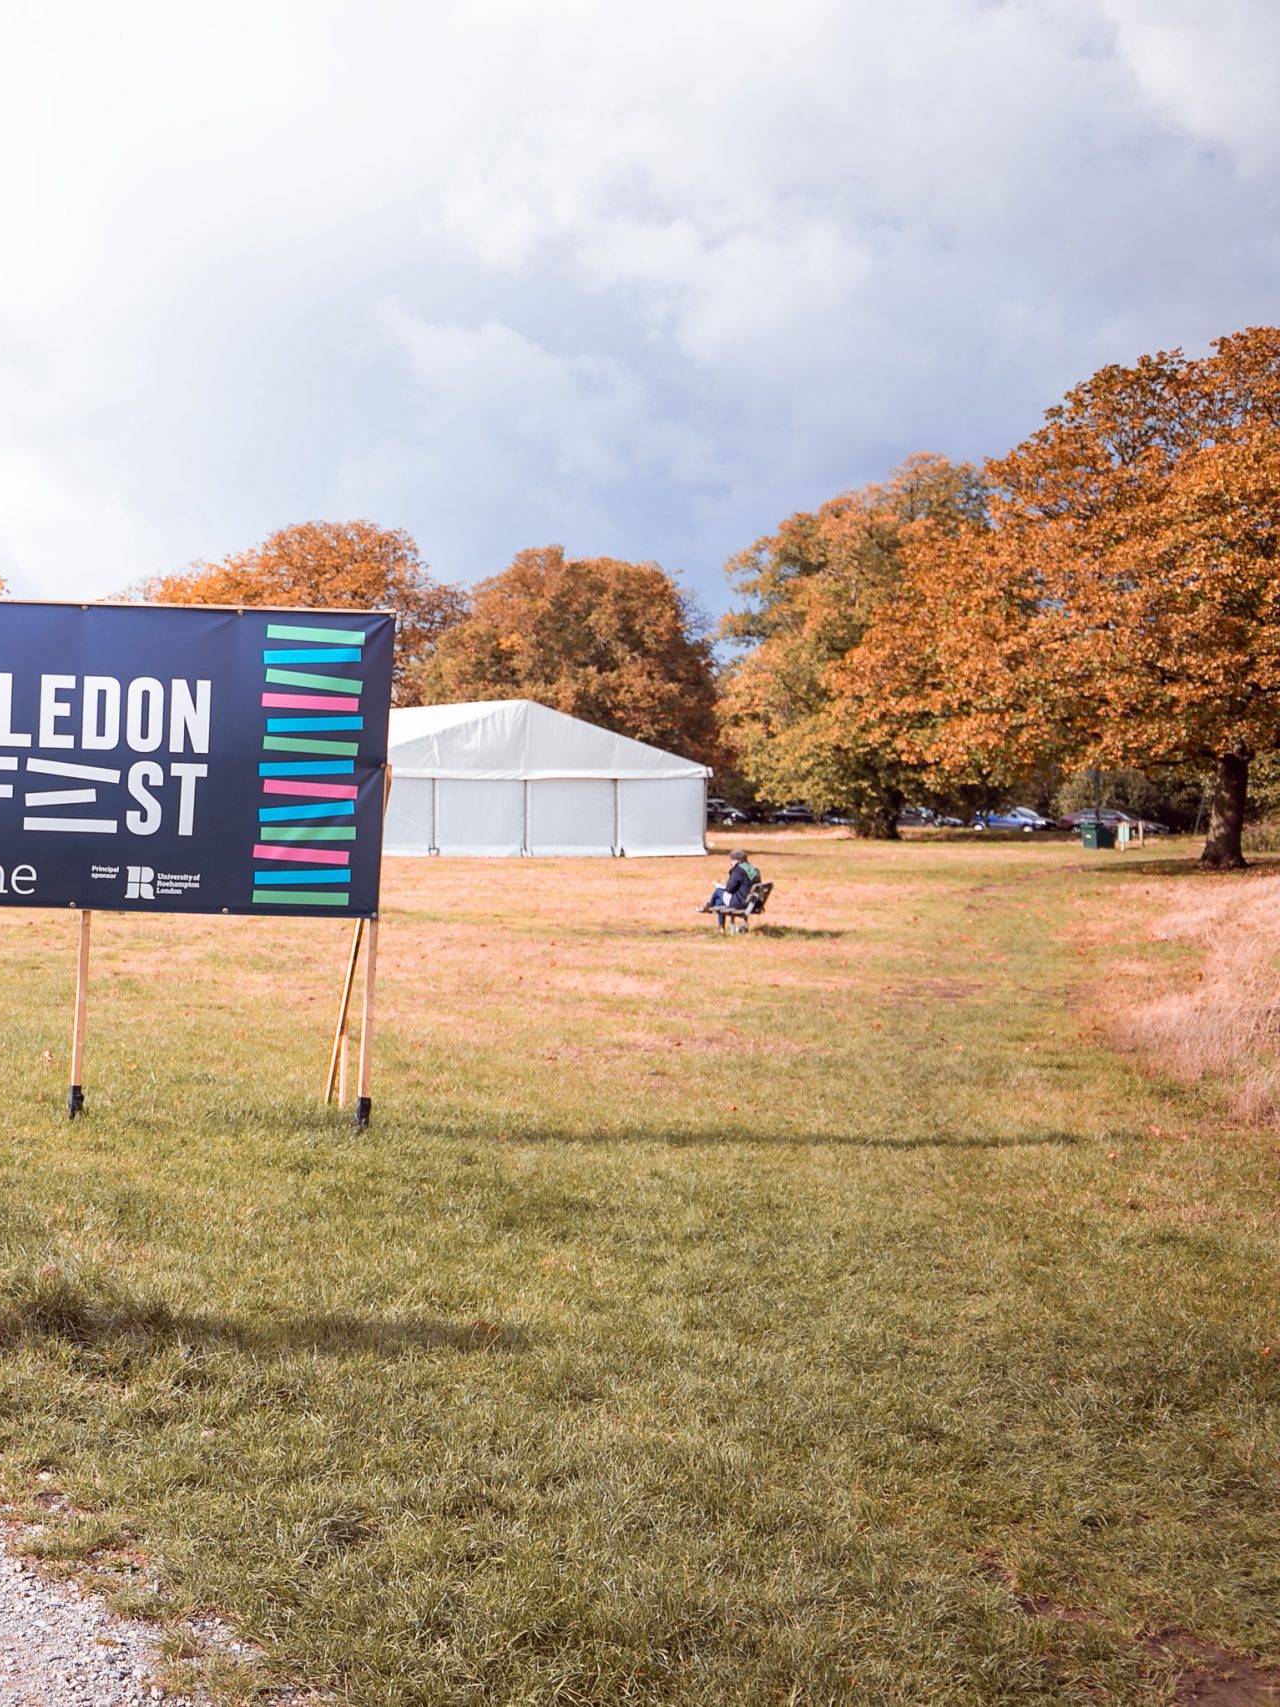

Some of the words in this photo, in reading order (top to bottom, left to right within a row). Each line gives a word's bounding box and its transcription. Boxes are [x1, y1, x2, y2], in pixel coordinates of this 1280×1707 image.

[91, 865, 119, 874] Principal
[157, 873, 193, 881] University
[156, 880, 200, 889] Roehampton
[156, 887, 182, 895] London
